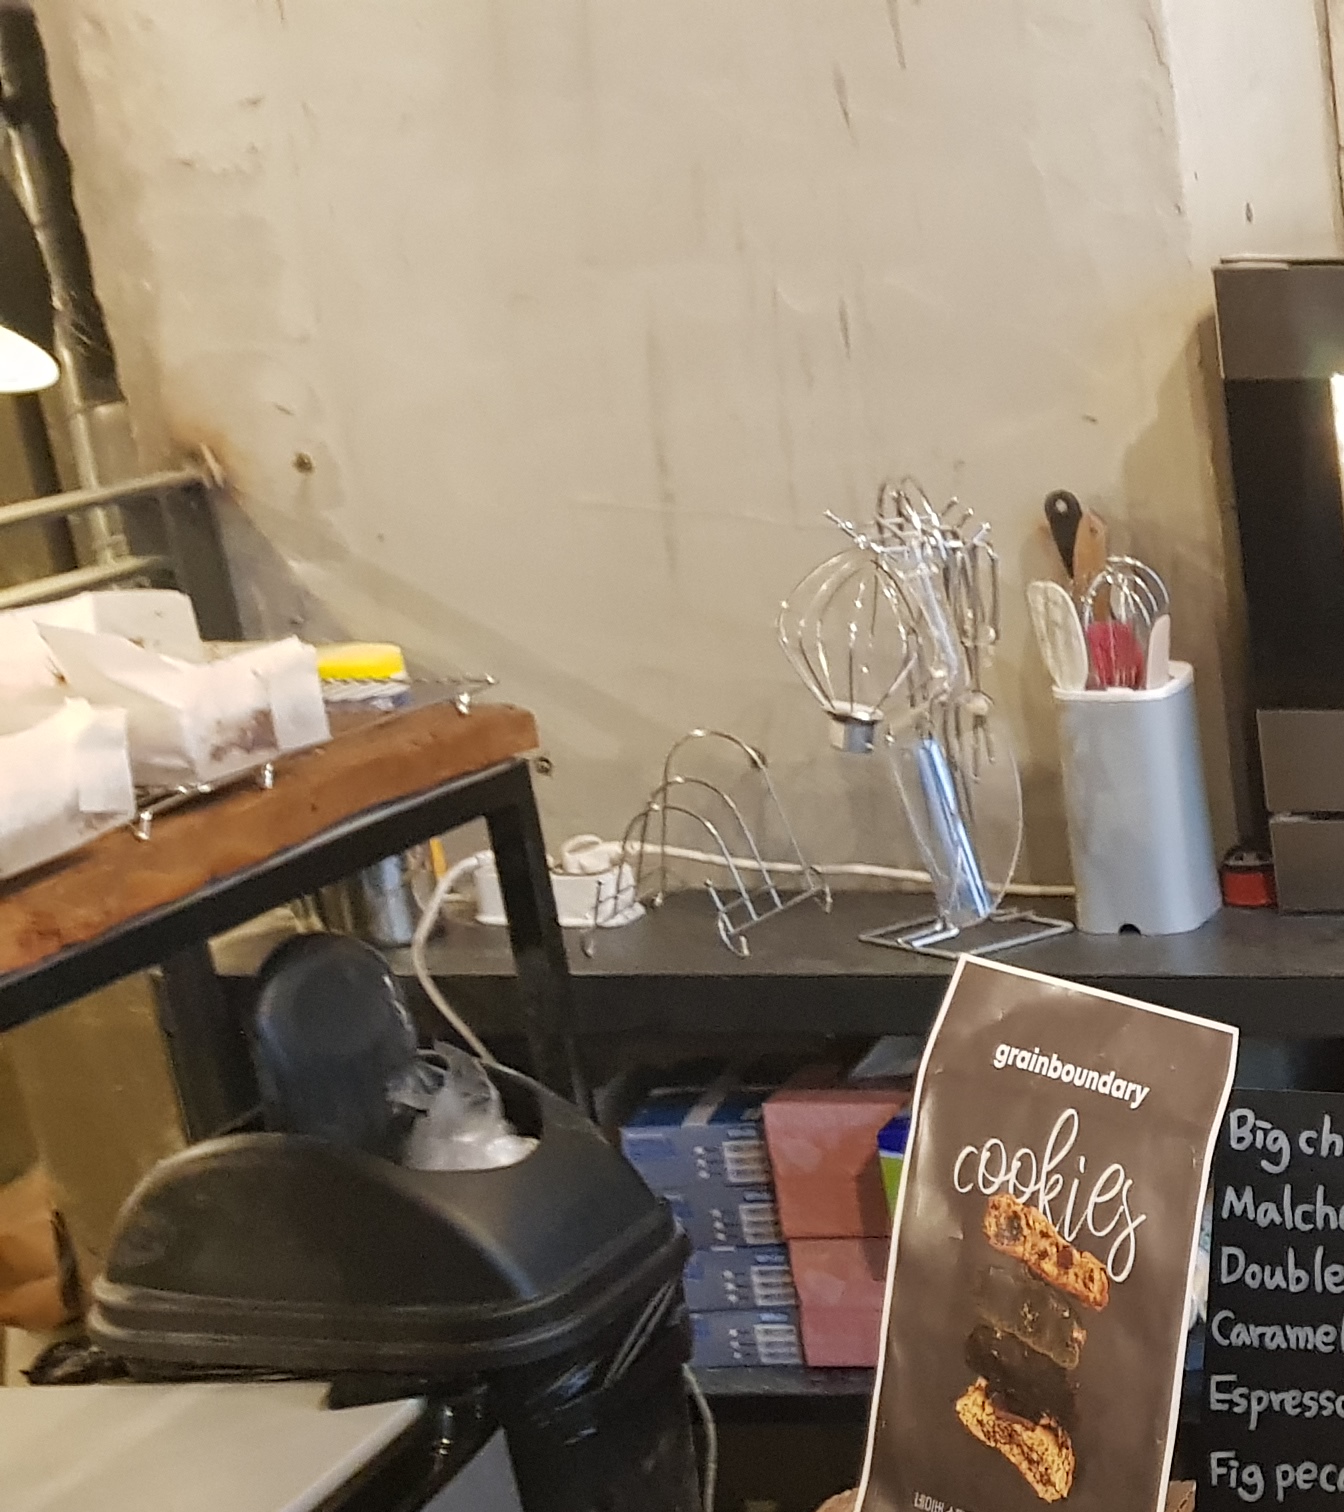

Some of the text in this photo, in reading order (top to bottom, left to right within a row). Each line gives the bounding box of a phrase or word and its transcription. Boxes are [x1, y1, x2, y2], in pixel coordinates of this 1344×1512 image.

[993, 1043, 1150, 1109] grainboundary
[1229, 1108, 1291, 1174] Big
[953, 1108, 1147, 1283] cookies
[1210, 1450, 1264, 1502] Fig
